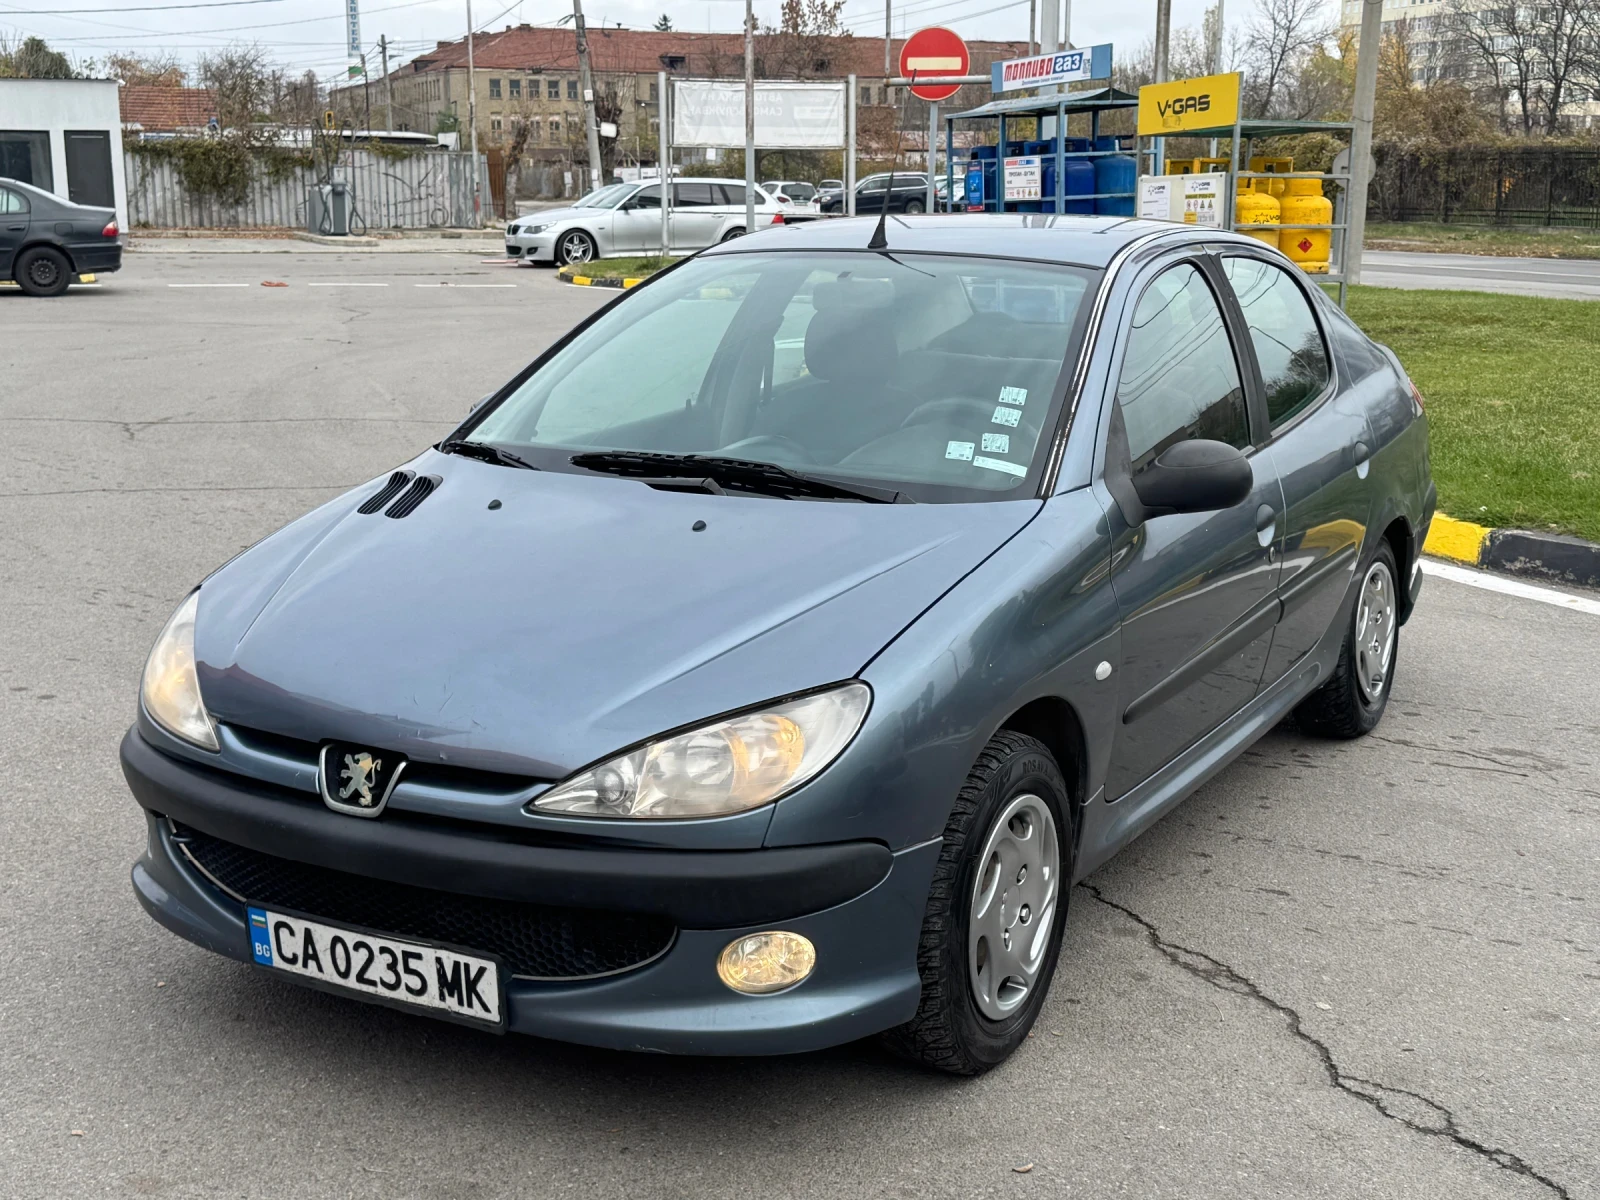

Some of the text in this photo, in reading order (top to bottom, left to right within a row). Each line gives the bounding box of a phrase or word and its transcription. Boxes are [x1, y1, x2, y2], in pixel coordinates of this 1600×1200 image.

[255, 943, 271, 958] BG
[273, 920, 492, 1014] CA 0235 MK
